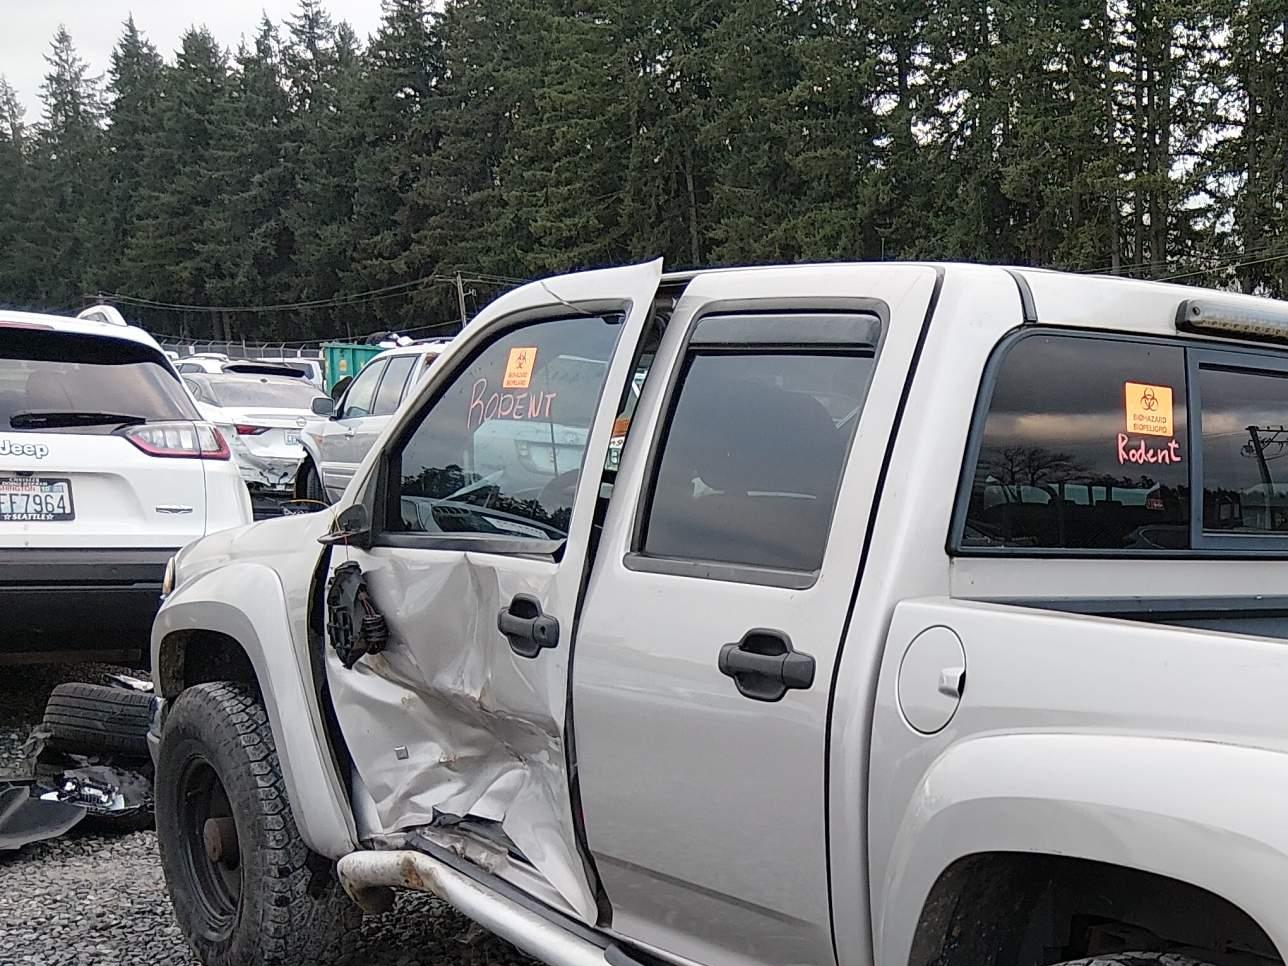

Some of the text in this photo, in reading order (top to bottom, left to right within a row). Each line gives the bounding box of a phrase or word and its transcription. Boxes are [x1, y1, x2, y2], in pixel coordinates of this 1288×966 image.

[467, 378, 556, 429] RODENT
[0, 440, 49, 460] Jeep
[1118, 433, 1181, 464] Rodent
